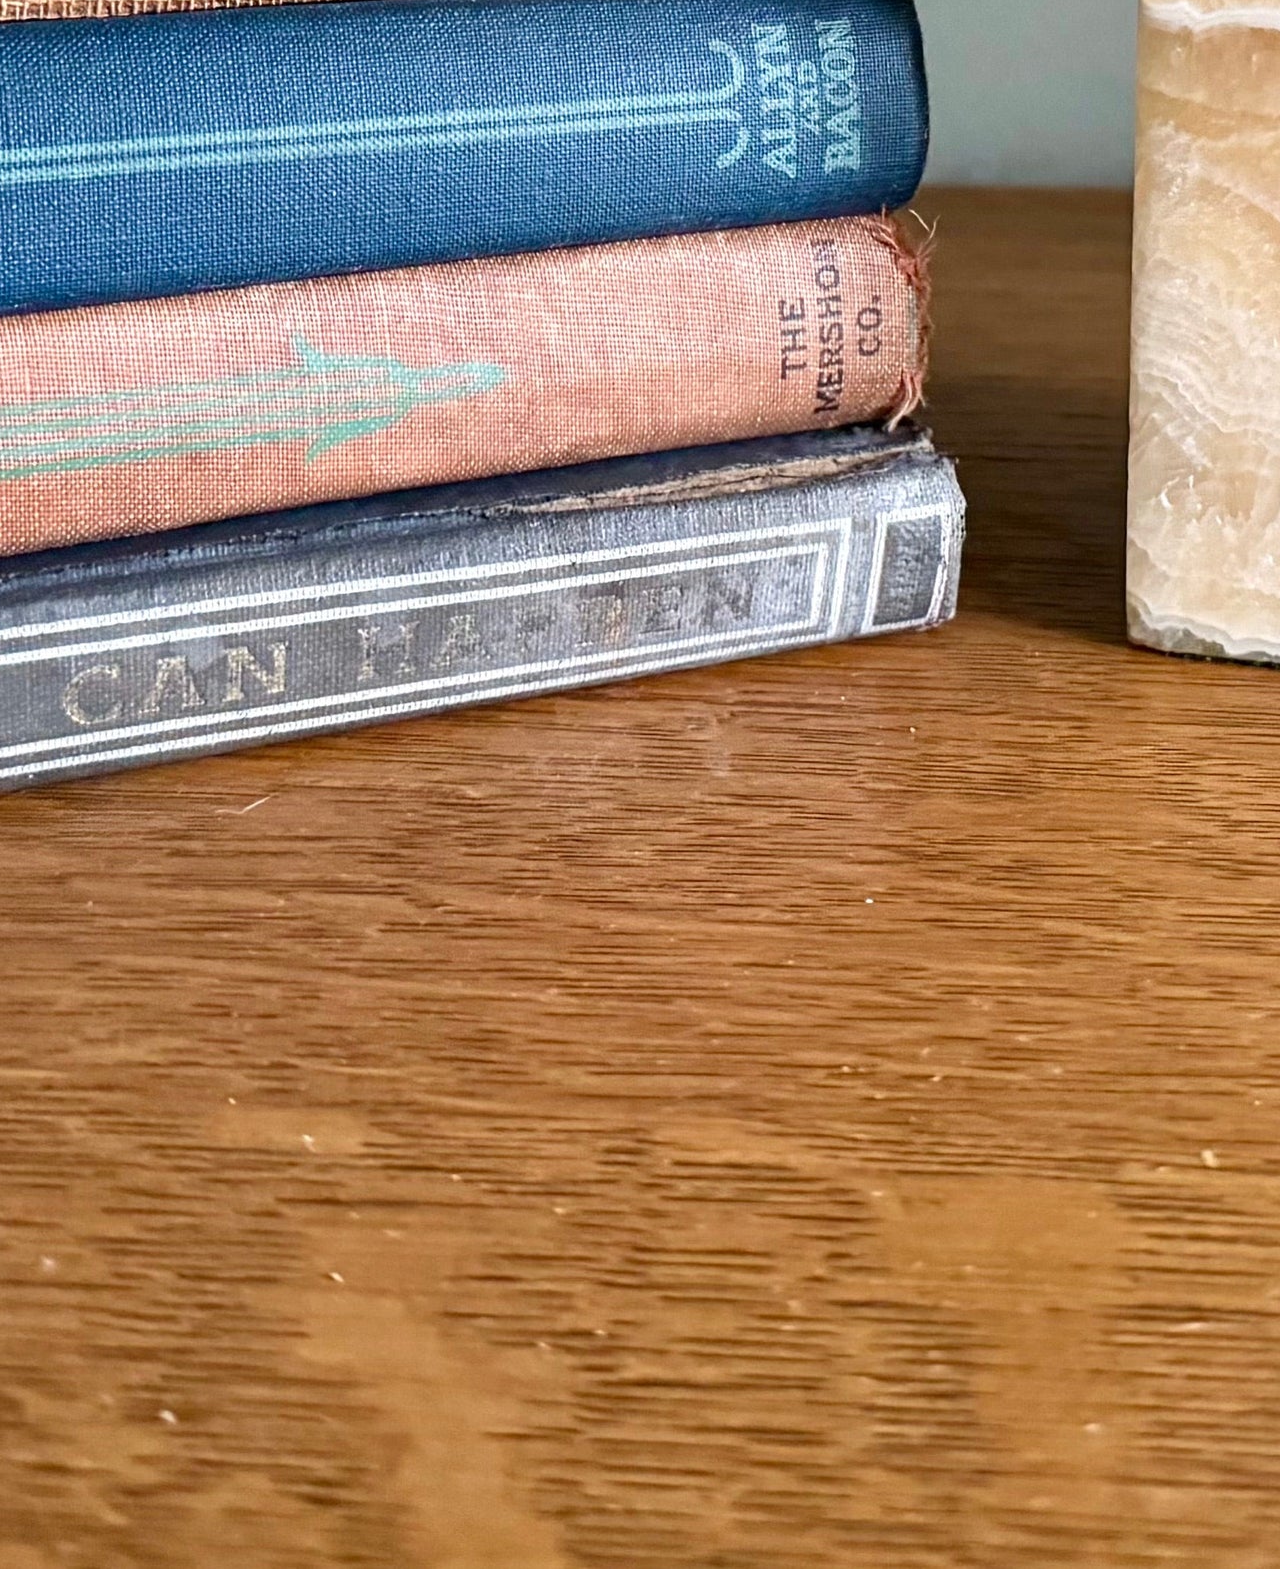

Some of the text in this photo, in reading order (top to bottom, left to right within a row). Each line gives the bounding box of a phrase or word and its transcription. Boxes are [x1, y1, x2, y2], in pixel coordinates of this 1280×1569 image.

[751, 22, 797, 178] ALLYN
[816, 17, 861, 175] BACON
[778, 297, 807, 380] THE
[810, 238, 844, 414] MERSHON
[855, 294, 883, 357] CO.
[62, 642, 289, 727] CAN
